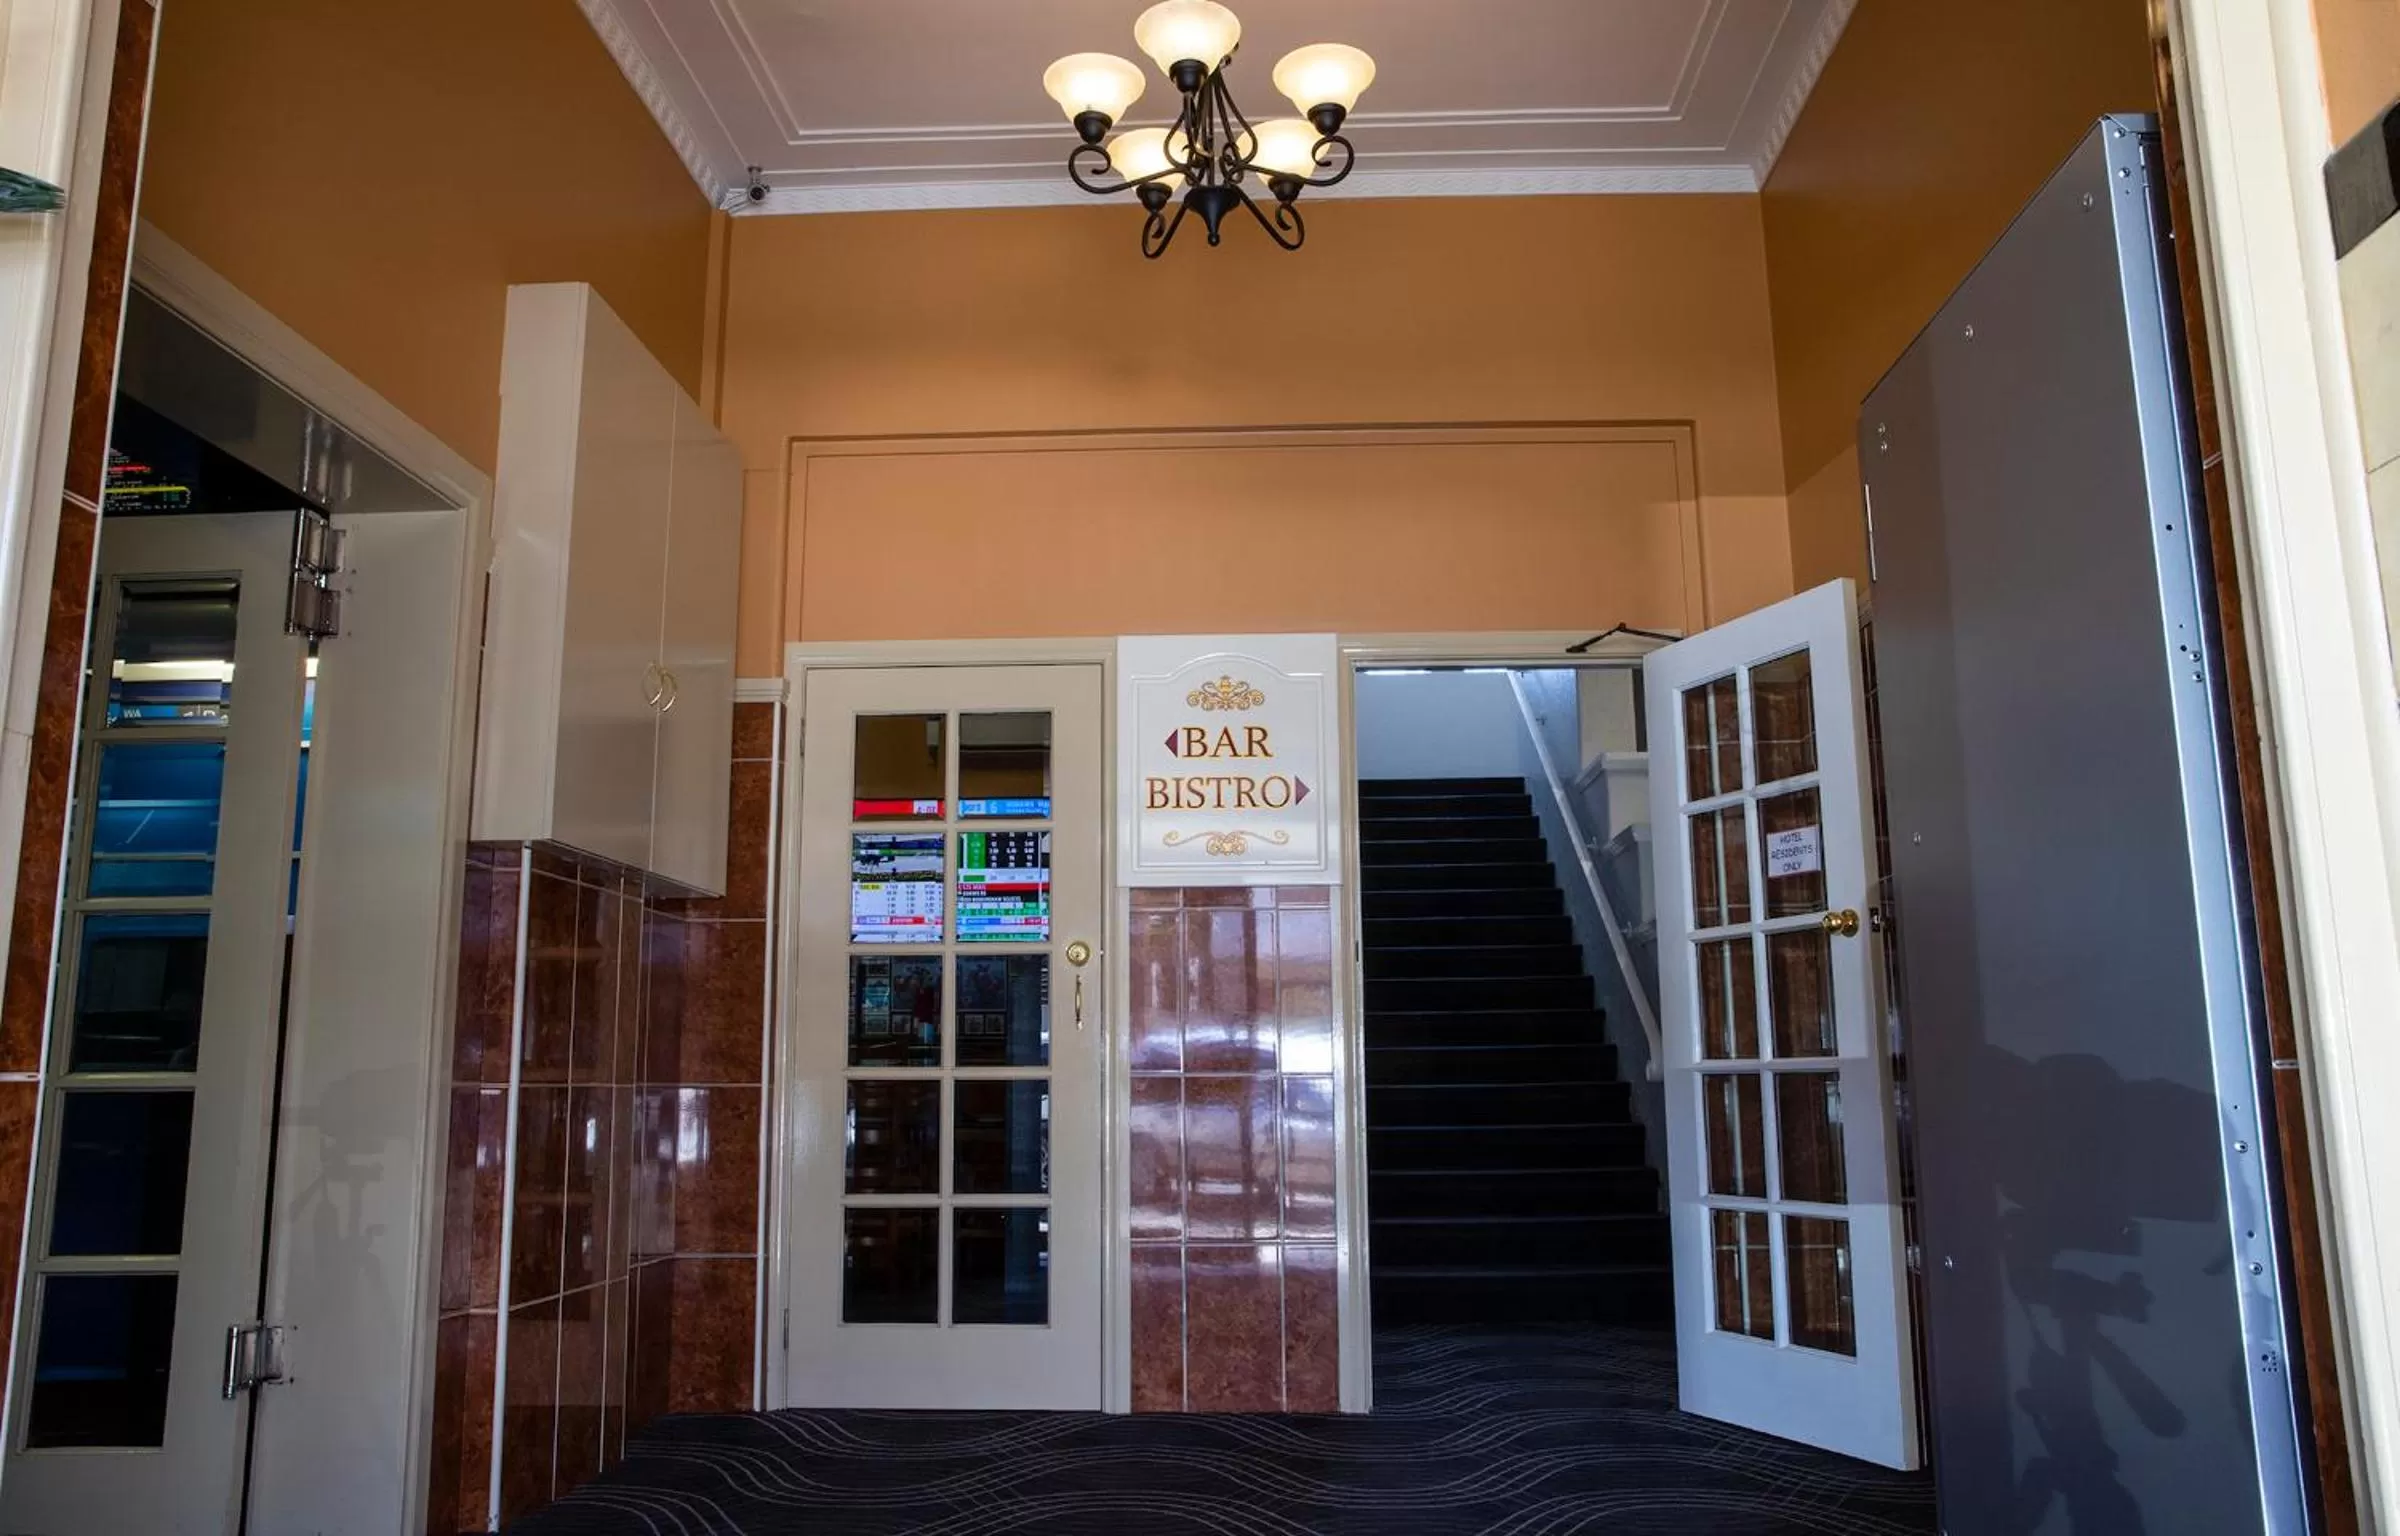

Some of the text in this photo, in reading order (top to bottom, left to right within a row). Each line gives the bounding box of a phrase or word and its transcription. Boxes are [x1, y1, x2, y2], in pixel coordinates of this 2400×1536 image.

[1182, 725, 1274, 758] BAR
[1145, 775, 1291, 810] BISTRO
[1780, 832, 1803, 843] HOTEL
[1771, 844, 1814, 860] RESIDENTS
[1782, 861, 1803, 873] ONLY
